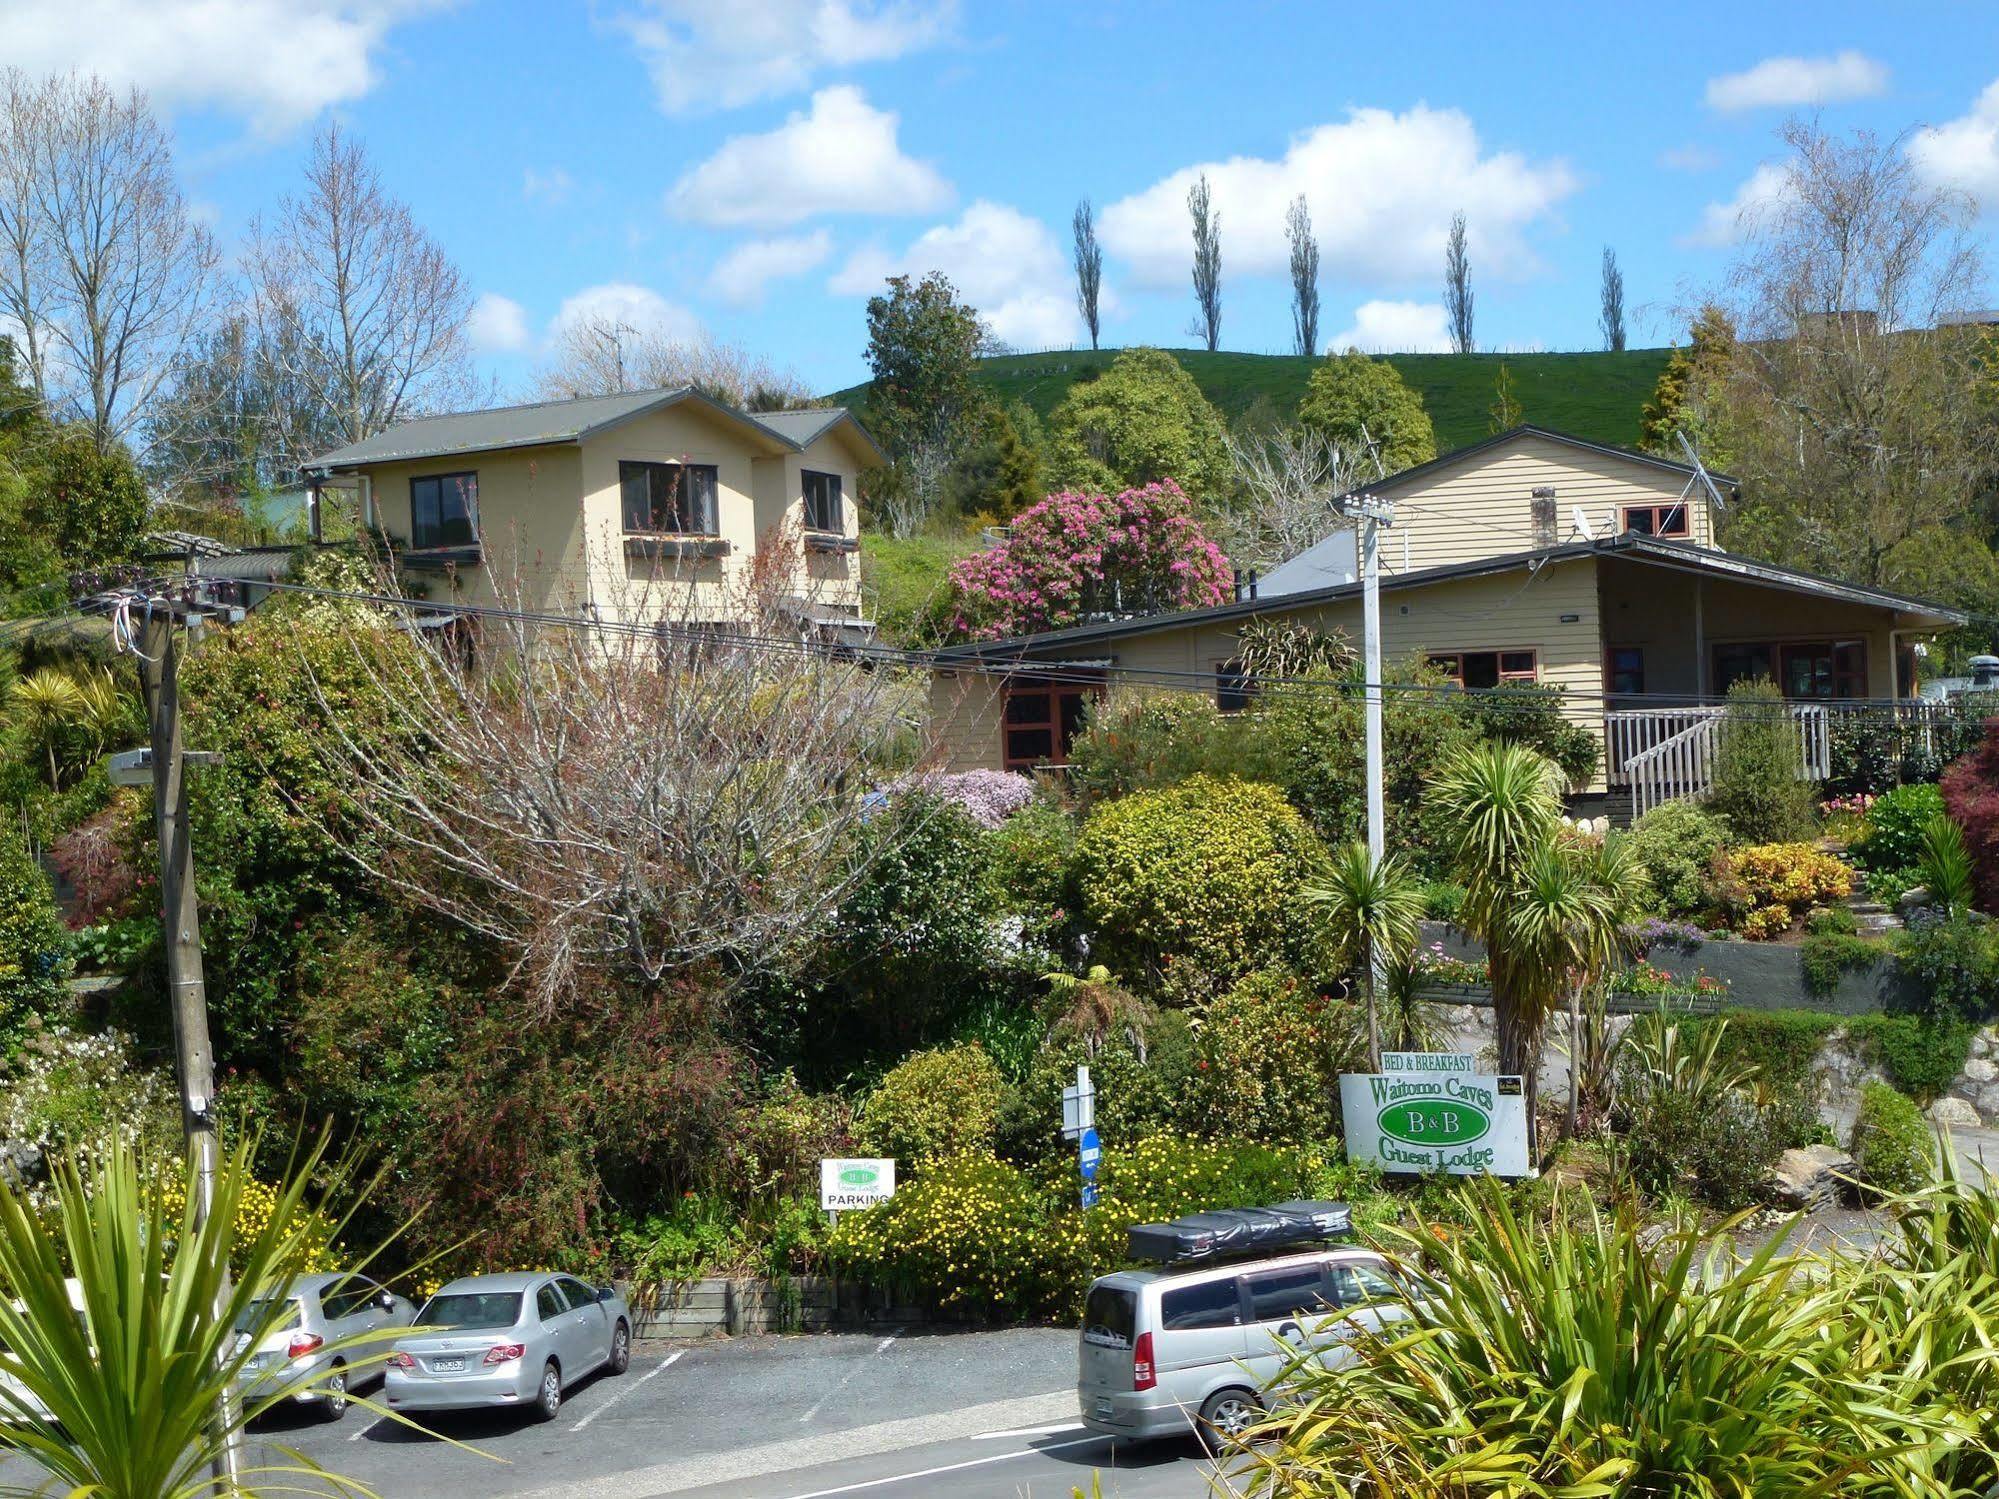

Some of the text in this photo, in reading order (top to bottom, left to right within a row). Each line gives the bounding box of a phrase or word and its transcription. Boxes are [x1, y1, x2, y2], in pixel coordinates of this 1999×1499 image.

[1383, 1054, 1472, 1072] BED & BREAKFAST
[1368, 1077, 1442, 1108] Waitomo
[1445, 1077, 1494, 1112] Caves
[1378, 1135, 1494, 1172] Guest Lodge
[828, 1194, 890, 1205] PARKING
